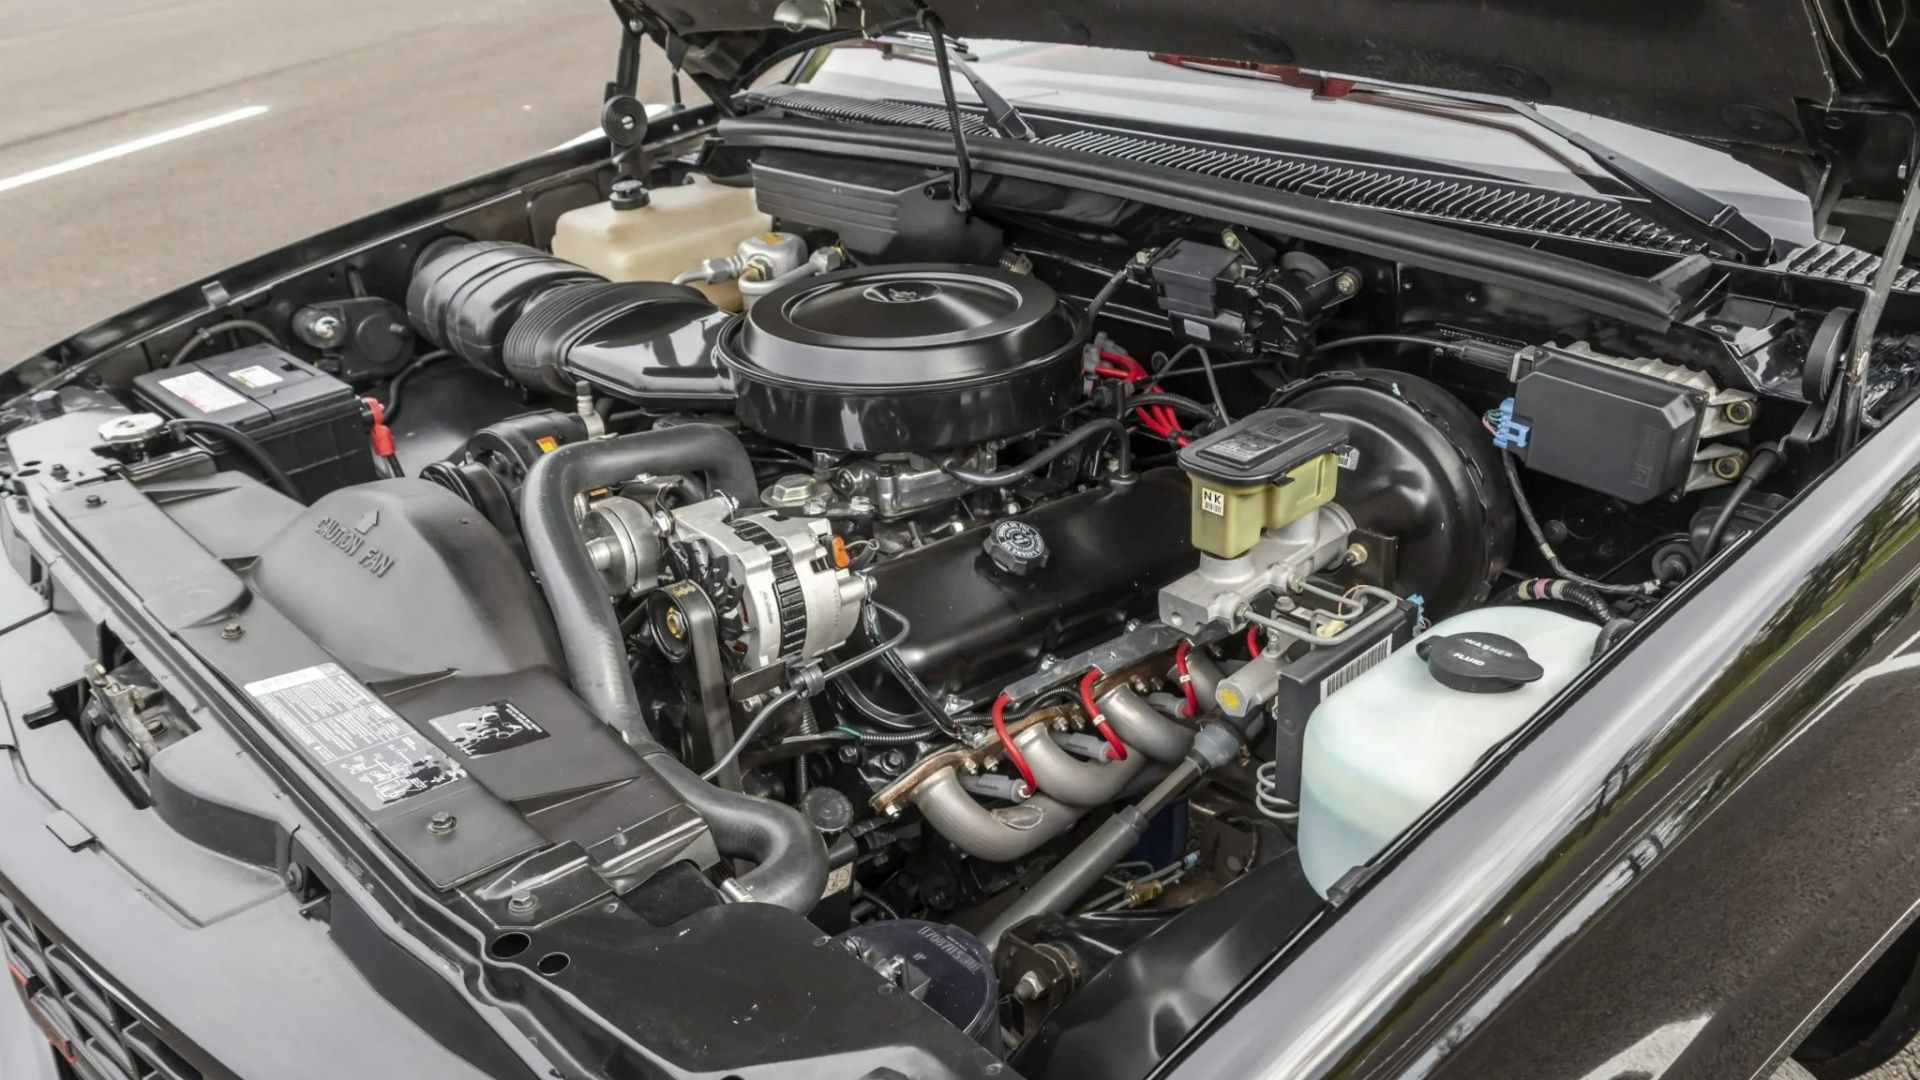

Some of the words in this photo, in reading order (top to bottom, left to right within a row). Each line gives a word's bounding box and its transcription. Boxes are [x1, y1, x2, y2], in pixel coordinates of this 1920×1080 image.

[314, 517, 365, 557] CAUTION
[358, 549, 395, 578] FAN
[1464, 638, 1513, 658] WASHER
[1453, 652, 1486, 666] FLUID
